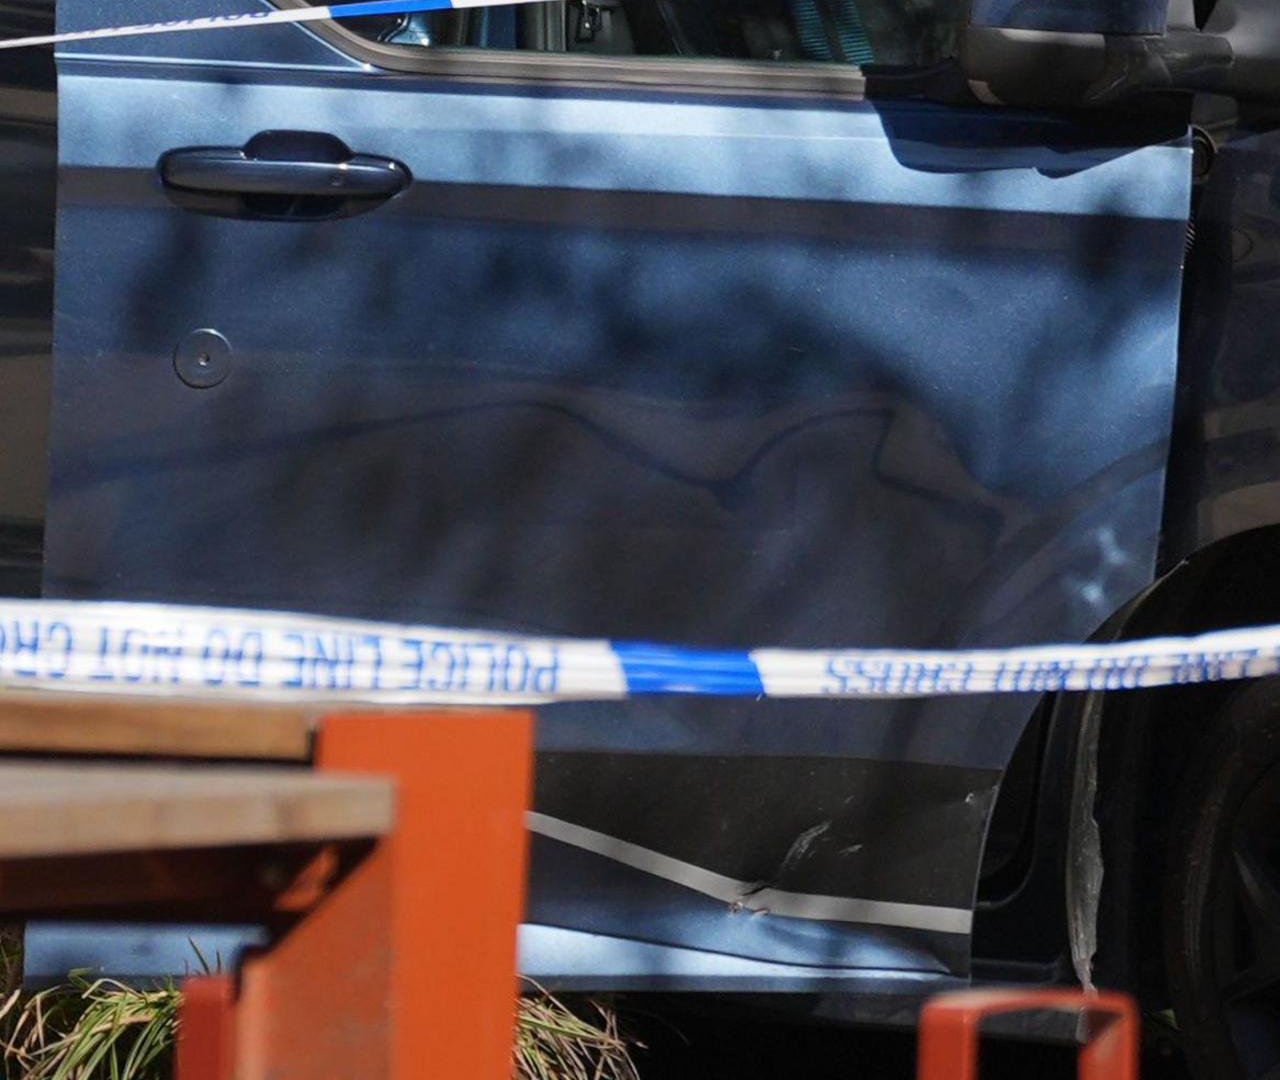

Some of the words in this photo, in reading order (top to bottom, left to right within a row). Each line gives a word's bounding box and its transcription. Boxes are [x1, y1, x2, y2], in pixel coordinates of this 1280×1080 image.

[0, 619, 72, 679] CR
[282, 631, 383, 691] LINE
[398, 636, 560, 696] POLICE
